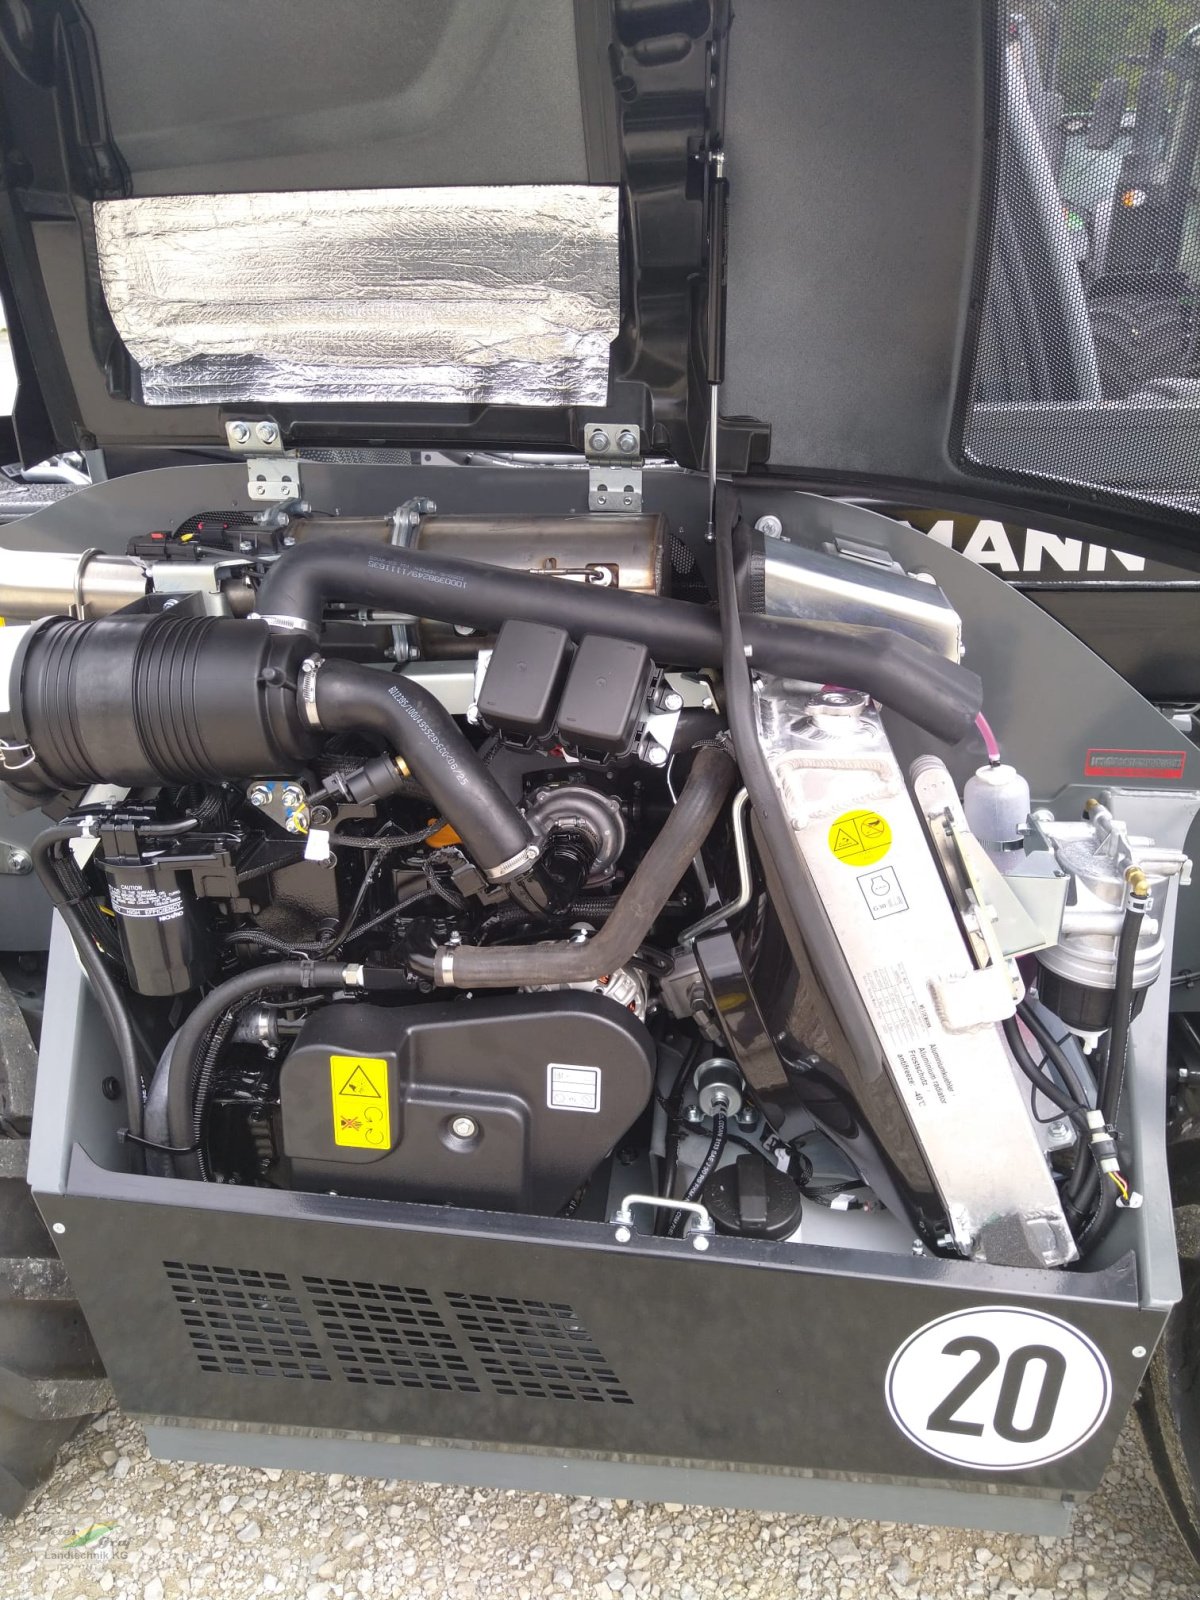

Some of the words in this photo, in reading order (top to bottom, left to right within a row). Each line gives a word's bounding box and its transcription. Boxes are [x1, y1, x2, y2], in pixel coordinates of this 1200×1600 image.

[144, 902, 181, 915] EFFICIENCY
[908, 1050, 928, 1086] Frostschutz
[918, 1047, 936, 1080] Aluminium
[933, 1080, 947, 1104] radiator
[926, 1335, 1067, 1444] 20
